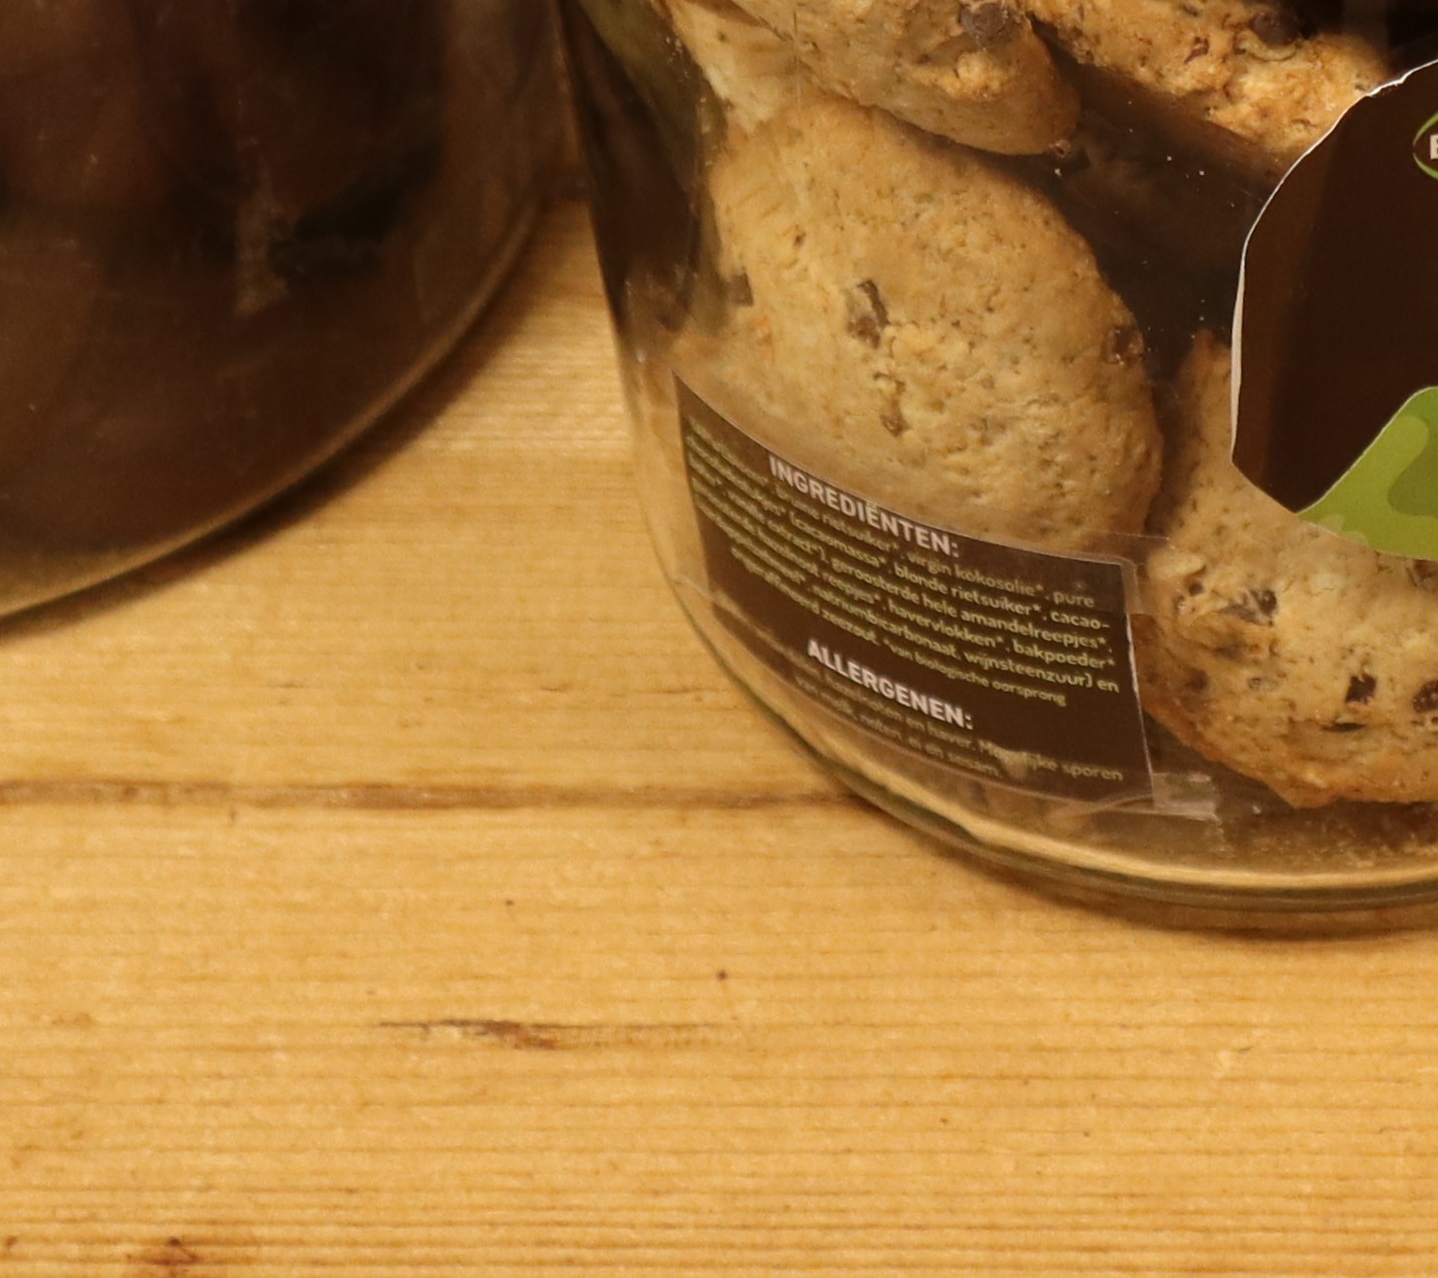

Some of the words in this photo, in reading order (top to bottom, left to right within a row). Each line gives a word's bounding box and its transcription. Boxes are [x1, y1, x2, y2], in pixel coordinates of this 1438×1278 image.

[768, 453, 961, 560] INGREDIËNTEN:
[830, 555, 921, 606] geroosterde
[921, 592, 958, 618] hele
[893, 561, 949, 594] blonde
[1049, 609, 1111, 631] cacao-
[906, 551, 952, 577] virgin
[1052, 589, 1096, 609] pure
[807, 637, 975, 732] ALLERGENEN:
[914, 650, 990, 688] biologische
[991, 679, 1067, 708] oorsprong
[963, 649, 1094, 689] wijnsteenzuur)
[1096, 679, 1120, 694] en
[1062, 760, 1125, 782] sporen
